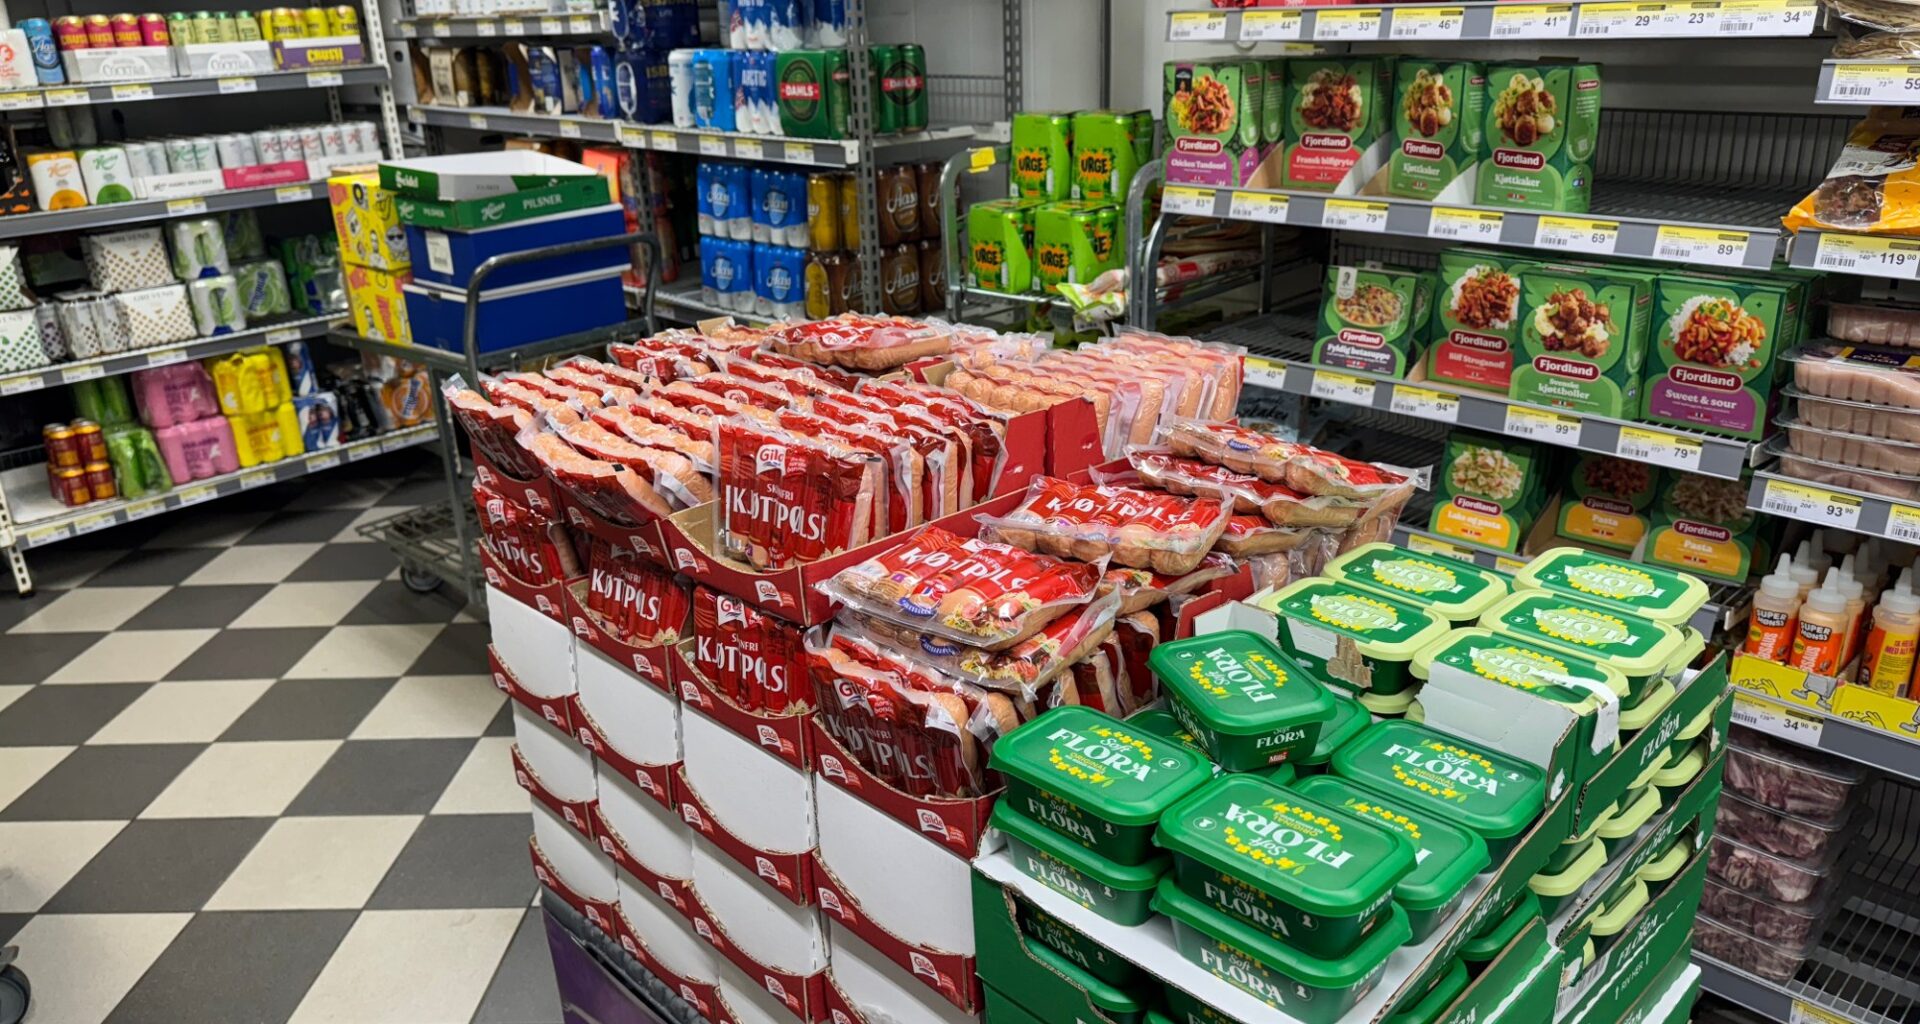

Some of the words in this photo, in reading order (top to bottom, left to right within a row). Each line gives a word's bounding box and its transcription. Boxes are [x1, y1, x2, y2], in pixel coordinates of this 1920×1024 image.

[1635, 15, 1650, 26] 29
[1688, 12, 1704, 24] 23
[1783, 11, 1800, 23] 34
[1438, 20, 1451, 30] 46
[785, 84, 814, 97] DAHLS
[1179, 139, 1217, 151] Fjordland
[1305, 136, 1347, 148] Fjordland
[1406, 142, 1440, 156] Fjordland
[1018, 157, 1044, 173] URGE
[1081, 156, 1109, 174] URGE
[1497, 152, 1540, 166] Fjordland
[1494, 173, 1541, 188] Kjøttkaker
[522, 193, 563, 211] PILSNER
[1366, 213, 1377, 223] 79
[1478, 223, 1492, 233] 99
[1592, 233, 1605, 244] 69
[1717, 244, 1734, 255] 89
[975, 252, 999, 265] URGE
[1040, 252, 1066, 268] URGE
[1880, 252, 1905, 265] 119
[1907, 253, 1917, 261] 00
[1342, 333, 1381, 345] Fjordland
[1455, 334, 1502, 349] Fjordland
[1539, 358, 1594, 377] Fjordland
[1675, 368, 1735, 388] Fjordland
[1665, 388, 1698, 403] Sweet
[1700, 396, 1709, 405] &
[1710, 398, 1738, 410] sour
[1555, 424, 1569, 435] 99
[1674, 447, 1688, 458] 79
[1457, 497, 1498, 515] Fjordland
[1585, 498, 1631, 515] Fjordland
[1826, 505, 1843, 516] 93
[1592, 514, 1618, 527] Pasta
[1678, 523, 1727, 539] Fjordland
[1683, 540, 1713, 554] Pasta
[1756, 608, 1788, 621] SUPER
[1801, 621, 1831, 636] SUPER
[1205, 647, 1277, 703] FLORA
[1783, 718, 1799, 731] 34
[1100, 736, 1133, 754] Soft
[1256, 729, 1306, 749] FLORA
[1639, 712, 1681, 767] FLORA
[1046, 728, 1151, 782] FLORA
[1437, 752, 1472, 768] Soft
[1381, 743, 1499, 797] FLORA
[919, 812, 944, 828] Gilde
[1027, 797, 1097, 845] FLORA
[1223, 802, 1355, 870] FLORA
[1027, 856, 1096, 905] FLORA
[1232, 884, 1256, 904] Soft
[1203, 880, 1291, 938] FLORA
[1025, 917, 1090, 969] FLORA
[1228, 953, 1252, 971] Soft
[1199, 946, 1286, 1006] FLORA
